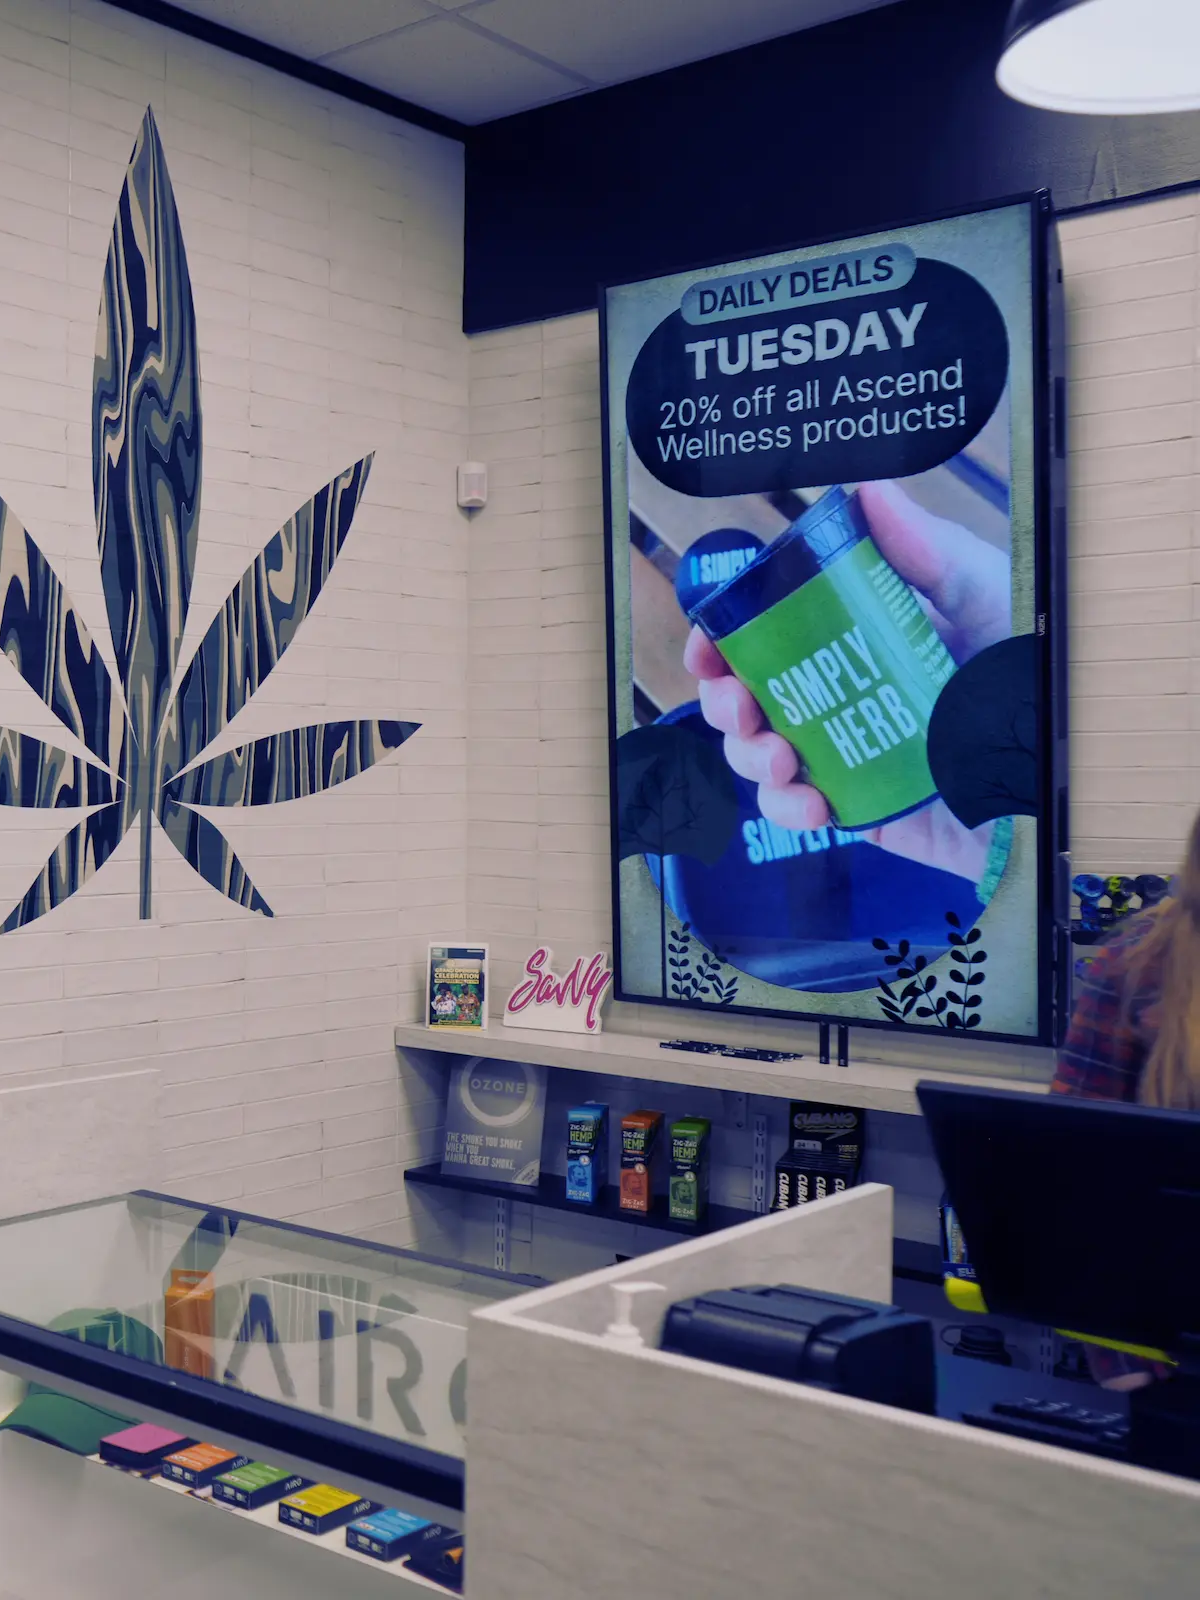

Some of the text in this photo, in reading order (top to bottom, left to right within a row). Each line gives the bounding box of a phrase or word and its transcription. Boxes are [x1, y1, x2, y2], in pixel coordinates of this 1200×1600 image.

[699, 254, 894, 317] DAILY DEALS
[685, 302, 929, 380] TUESDAY
[659, 358, 964, 430] 20% off all Ascend
[657, 395, 967, 462] Wellness products!
[767, 626, 883, 727] SIMPLY
[823, 684, 918, 769] HERB
[434, 972, 480, 980] CELEBRATION
[470, 1078, 526, 1094] OZONE
[793, 1112, 858, 1130] CUBANO
[446, 1131, 523, 1151] THE SMOKE YOU SMOKE
[569, 1130, 593, 1143] HEMP
[622, 1137, 645, 1151] HEMP
[445, 1142, 480, 1155] WHEN YOU
[672, 1145, 697, 1159] HEMP
[444, 1151, 468, 1165] WANNA
[469, 1154, 490, 1167] GREAT
[776, 1172, 789, 1210] CUBAN
